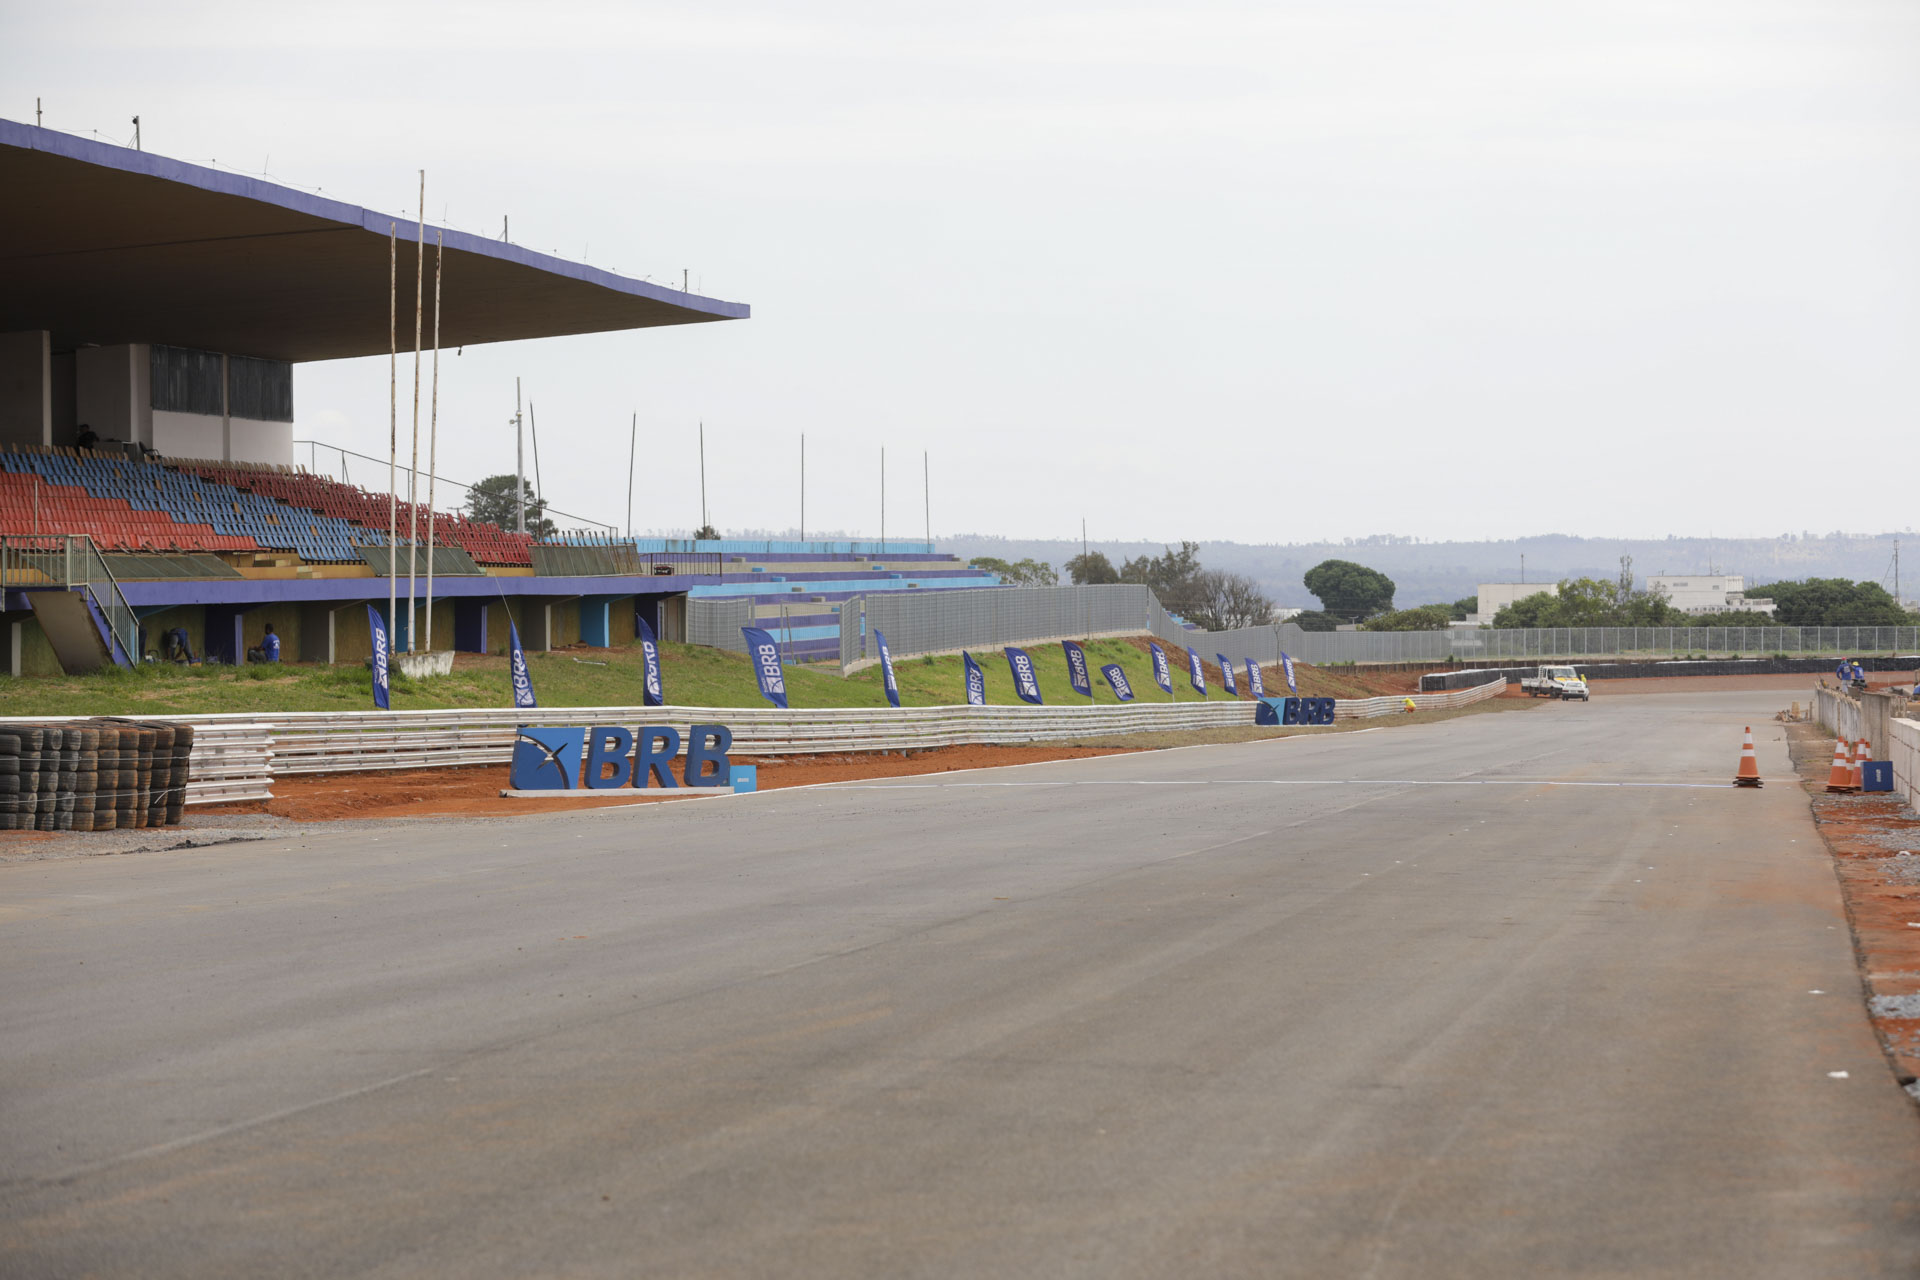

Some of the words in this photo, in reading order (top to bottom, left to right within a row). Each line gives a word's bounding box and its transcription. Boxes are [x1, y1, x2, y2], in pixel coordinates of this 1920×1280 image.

[375, 627, 387, 668] BRB
[758, 644, 781, 676] BRB
[1015, 655, 1034, 682] BRB
[1155, 651, 1169, 674] BRB
[1222, 661, 1233, 679] BRB
[1251, 663, 1261, 684] BRB
[1109, 667, 1126, 689] BRB
[1283, 697, 1336, 725] BRB
[584, 725, 733, 789] BRB
